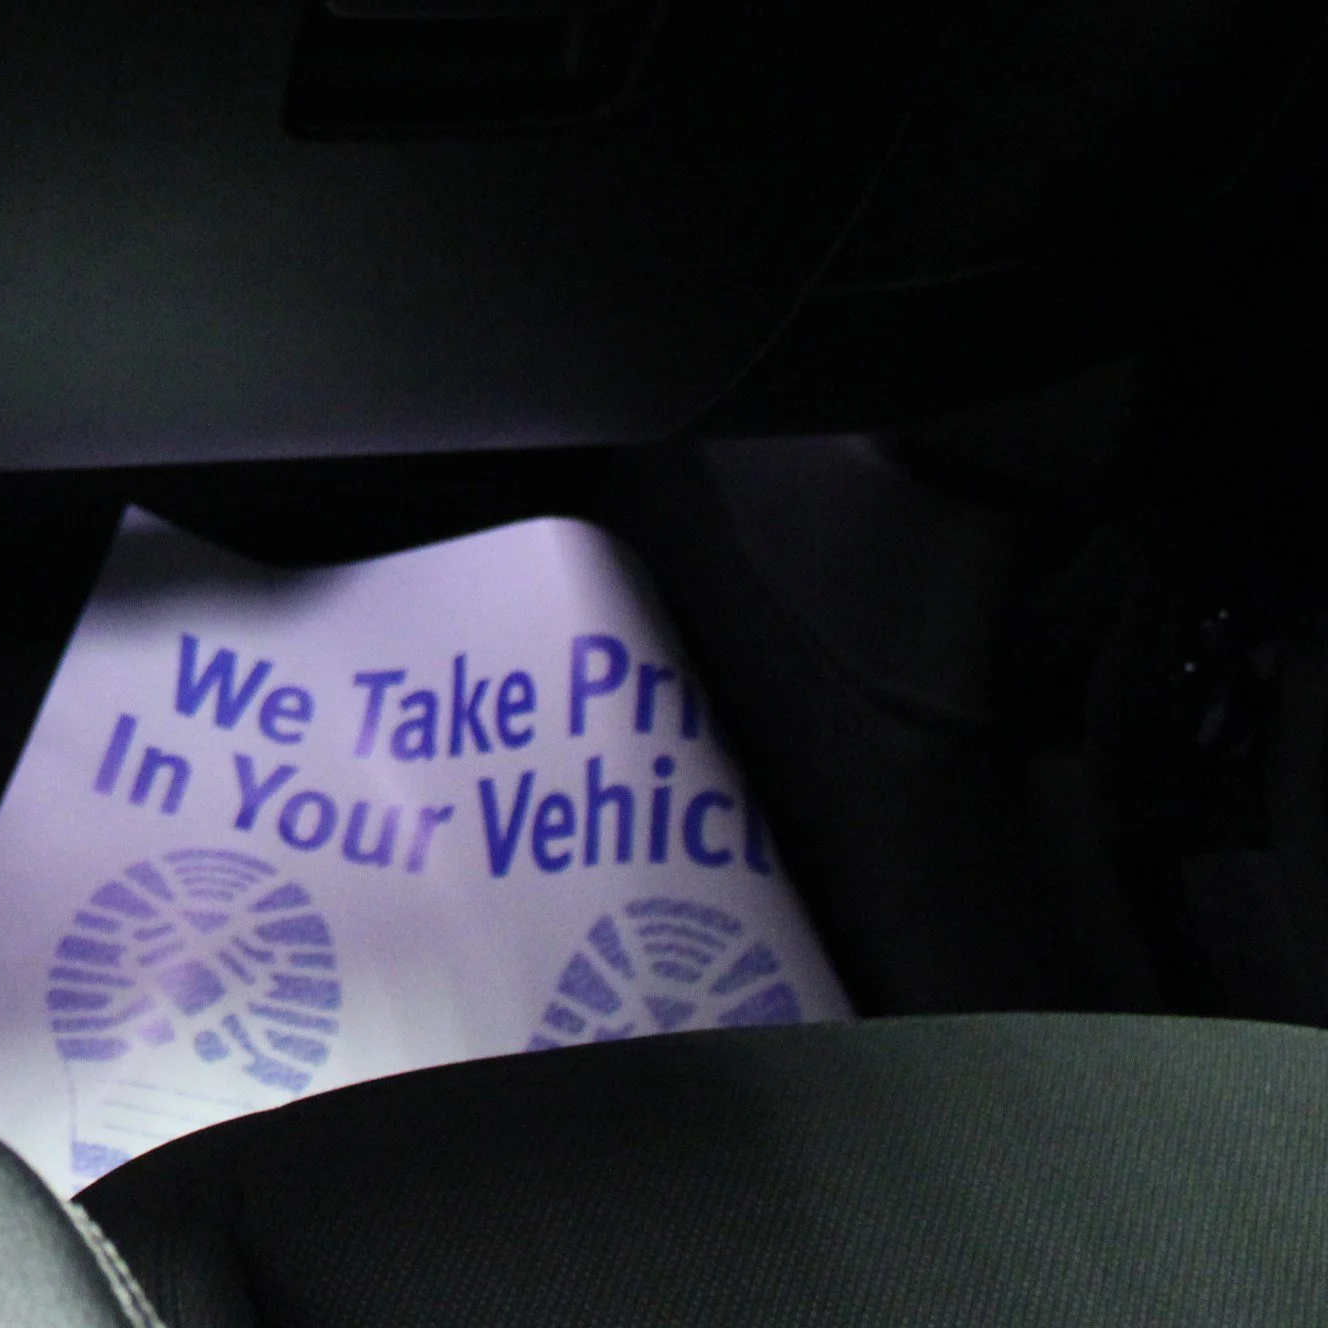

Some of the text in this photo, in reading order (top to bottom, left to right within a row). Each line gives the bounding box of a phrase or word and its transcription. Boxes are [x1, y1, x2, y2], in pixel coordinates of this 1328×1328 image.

[172, 633, 315, 746] We
[351, 652, 536, 762] Take
[92, 713, 191, 816] In
[232, 751, 456, 875] Your
